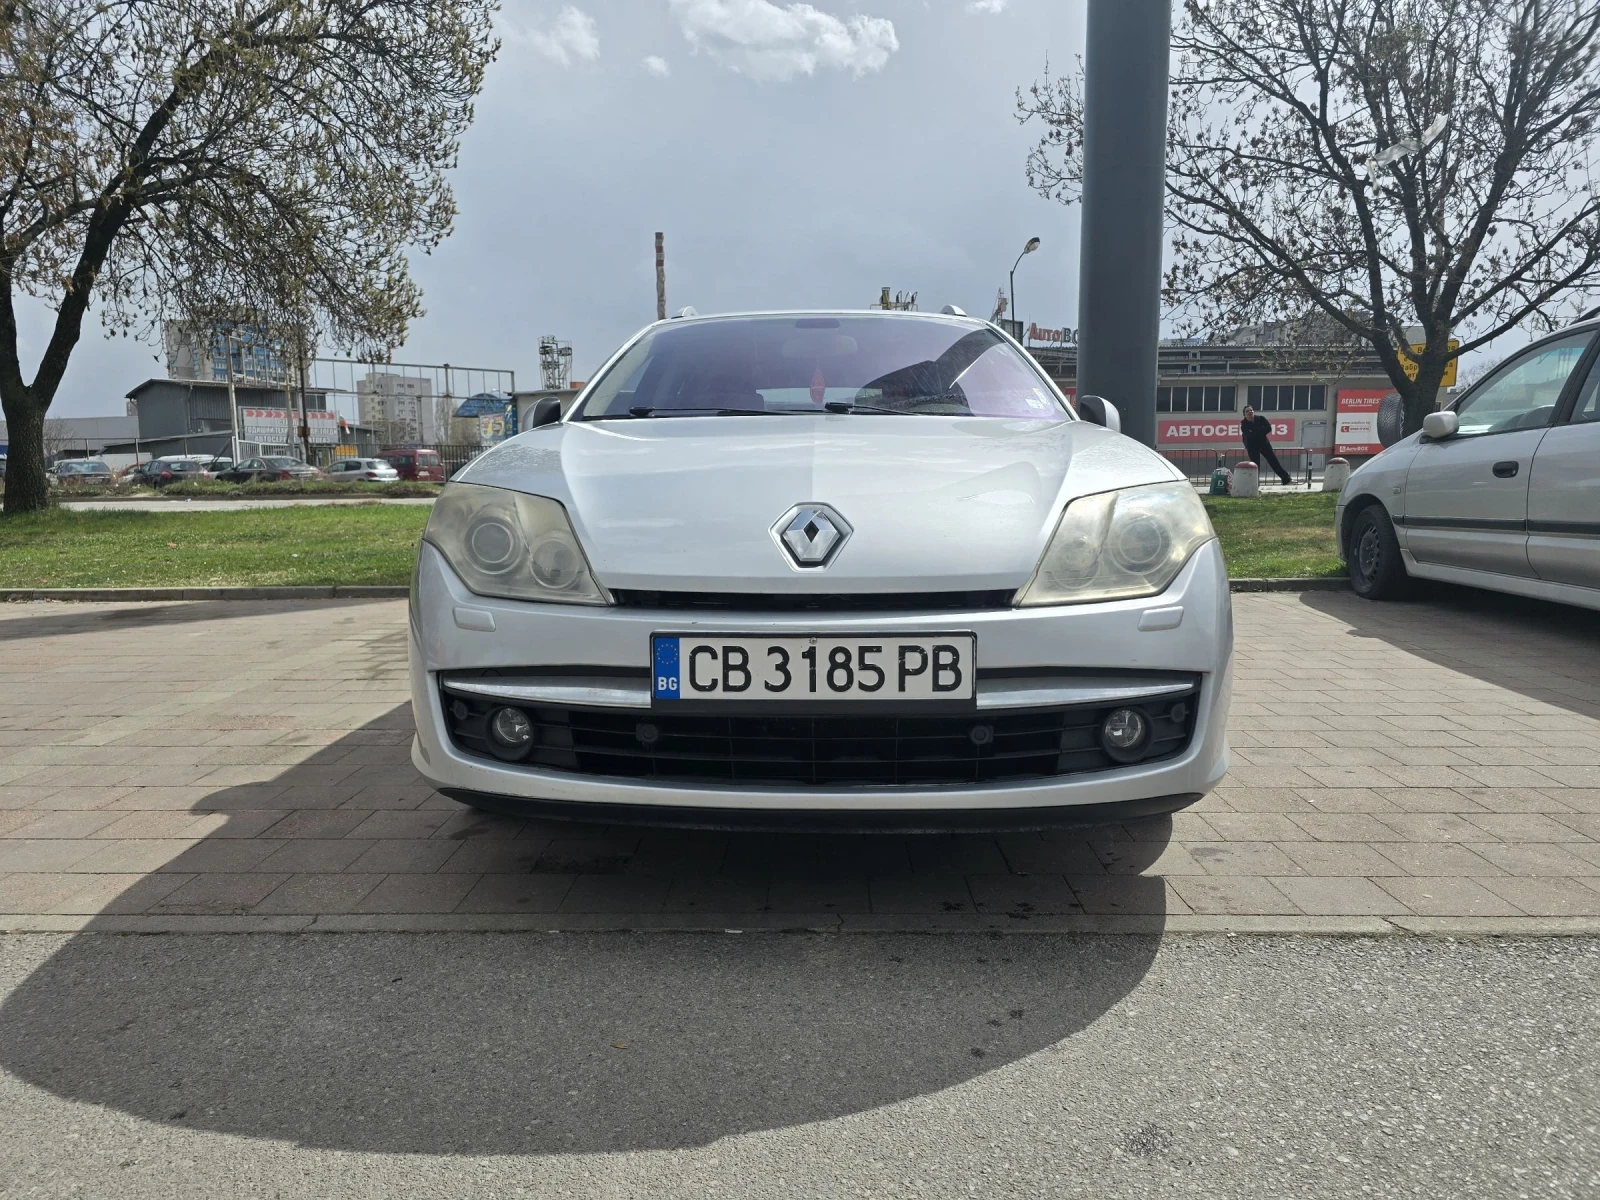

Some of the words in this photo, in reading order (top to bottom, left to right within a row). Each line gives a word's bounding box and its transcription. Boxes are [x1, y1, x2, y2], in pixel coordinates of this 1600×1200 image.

[1166, 424, 1288, 437] АВТОСЕЗ
[688, 645, 752, 693] CB
[764, 645, 886, 693] 3185
[898, 645, 962, 693] PB
[657, 677, 678, 691] BG
